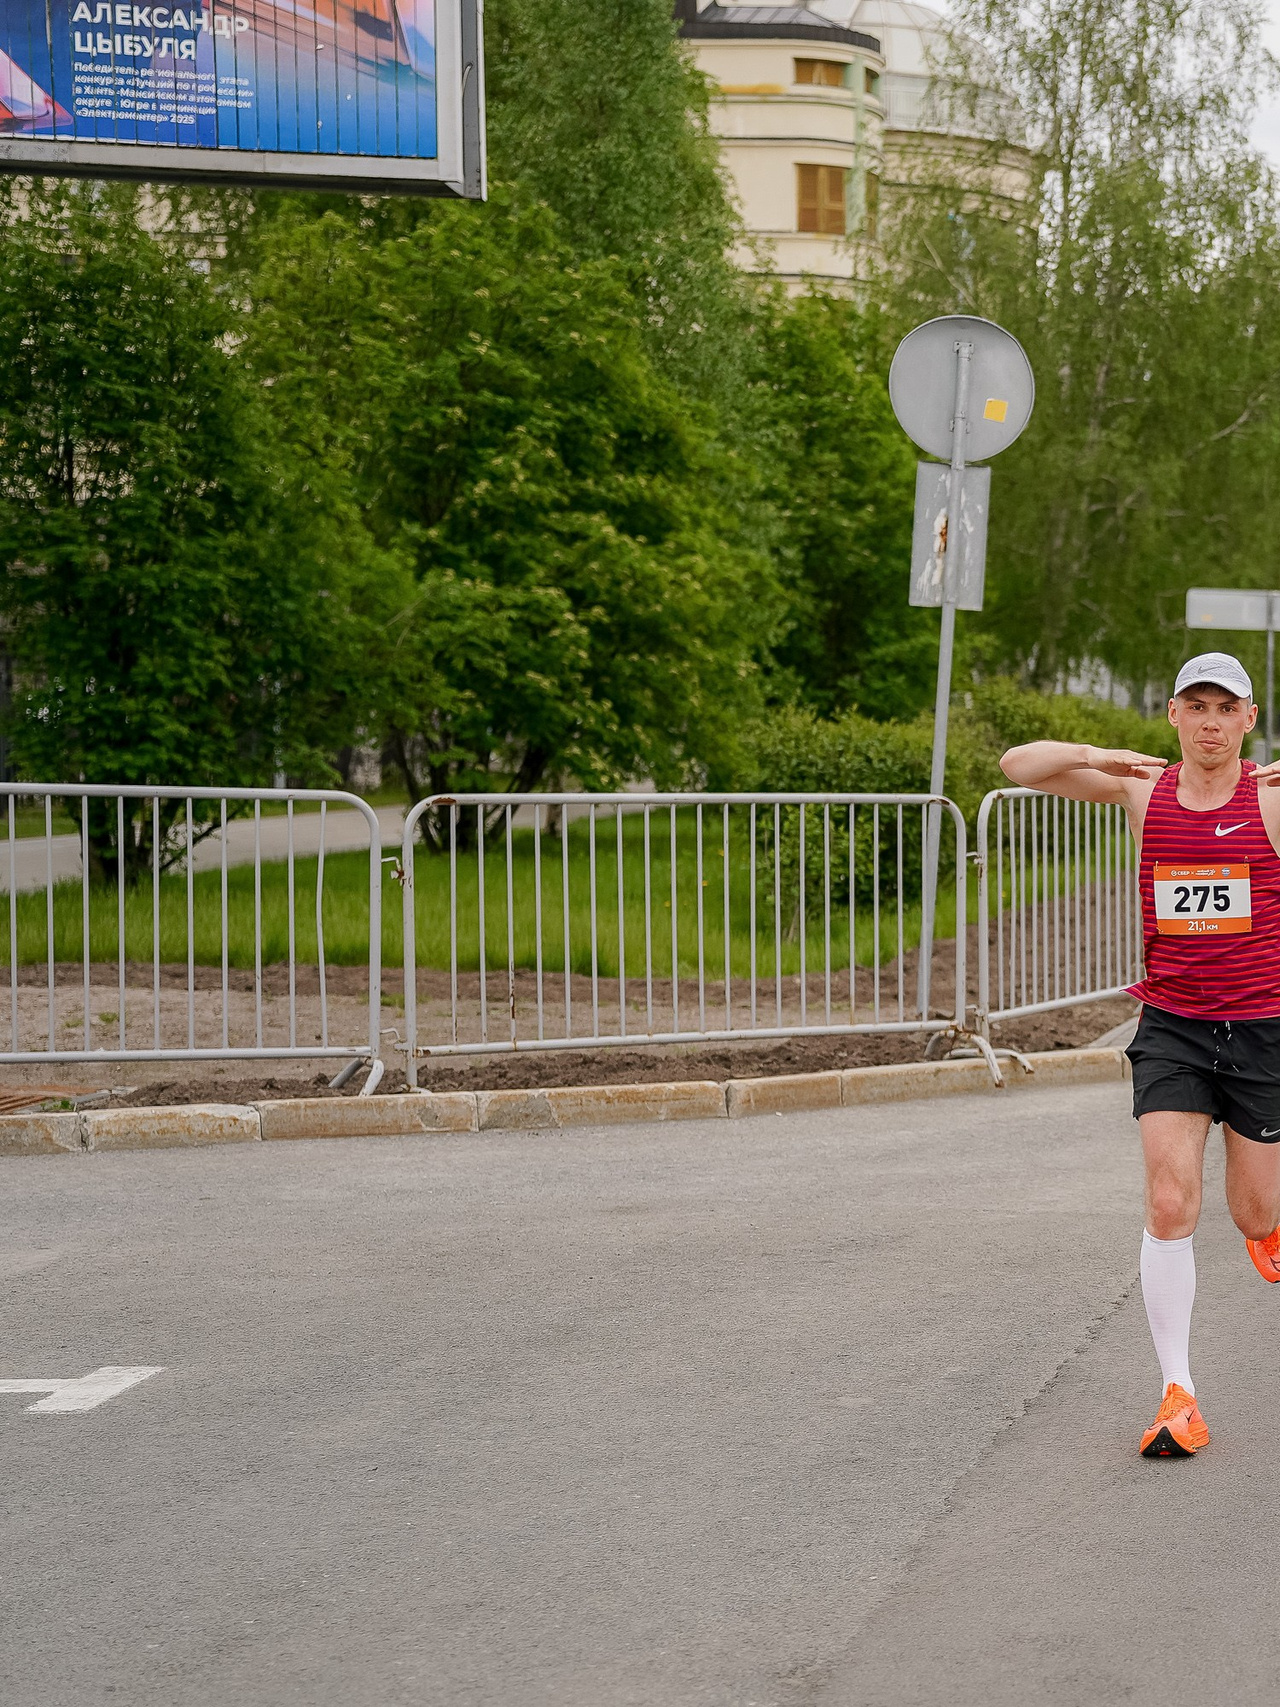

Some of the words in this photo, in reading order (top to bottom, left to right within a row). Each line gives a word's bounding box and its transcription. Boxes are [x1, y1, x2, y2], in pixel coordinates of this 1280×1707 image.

[72, 1, 250, 39] АЛЕКСАНДР
[74, 31, 197, 60] ЦЫБУЛЯ
[176, 81, 190, 90] по
[219, 76, 250, 86] этапа
[75, 85, 82, 94] в
[75, 97, 112, 107] округе
[170, 113, 195, 125] 2025
[1173, 885, 1231, 913] 275
